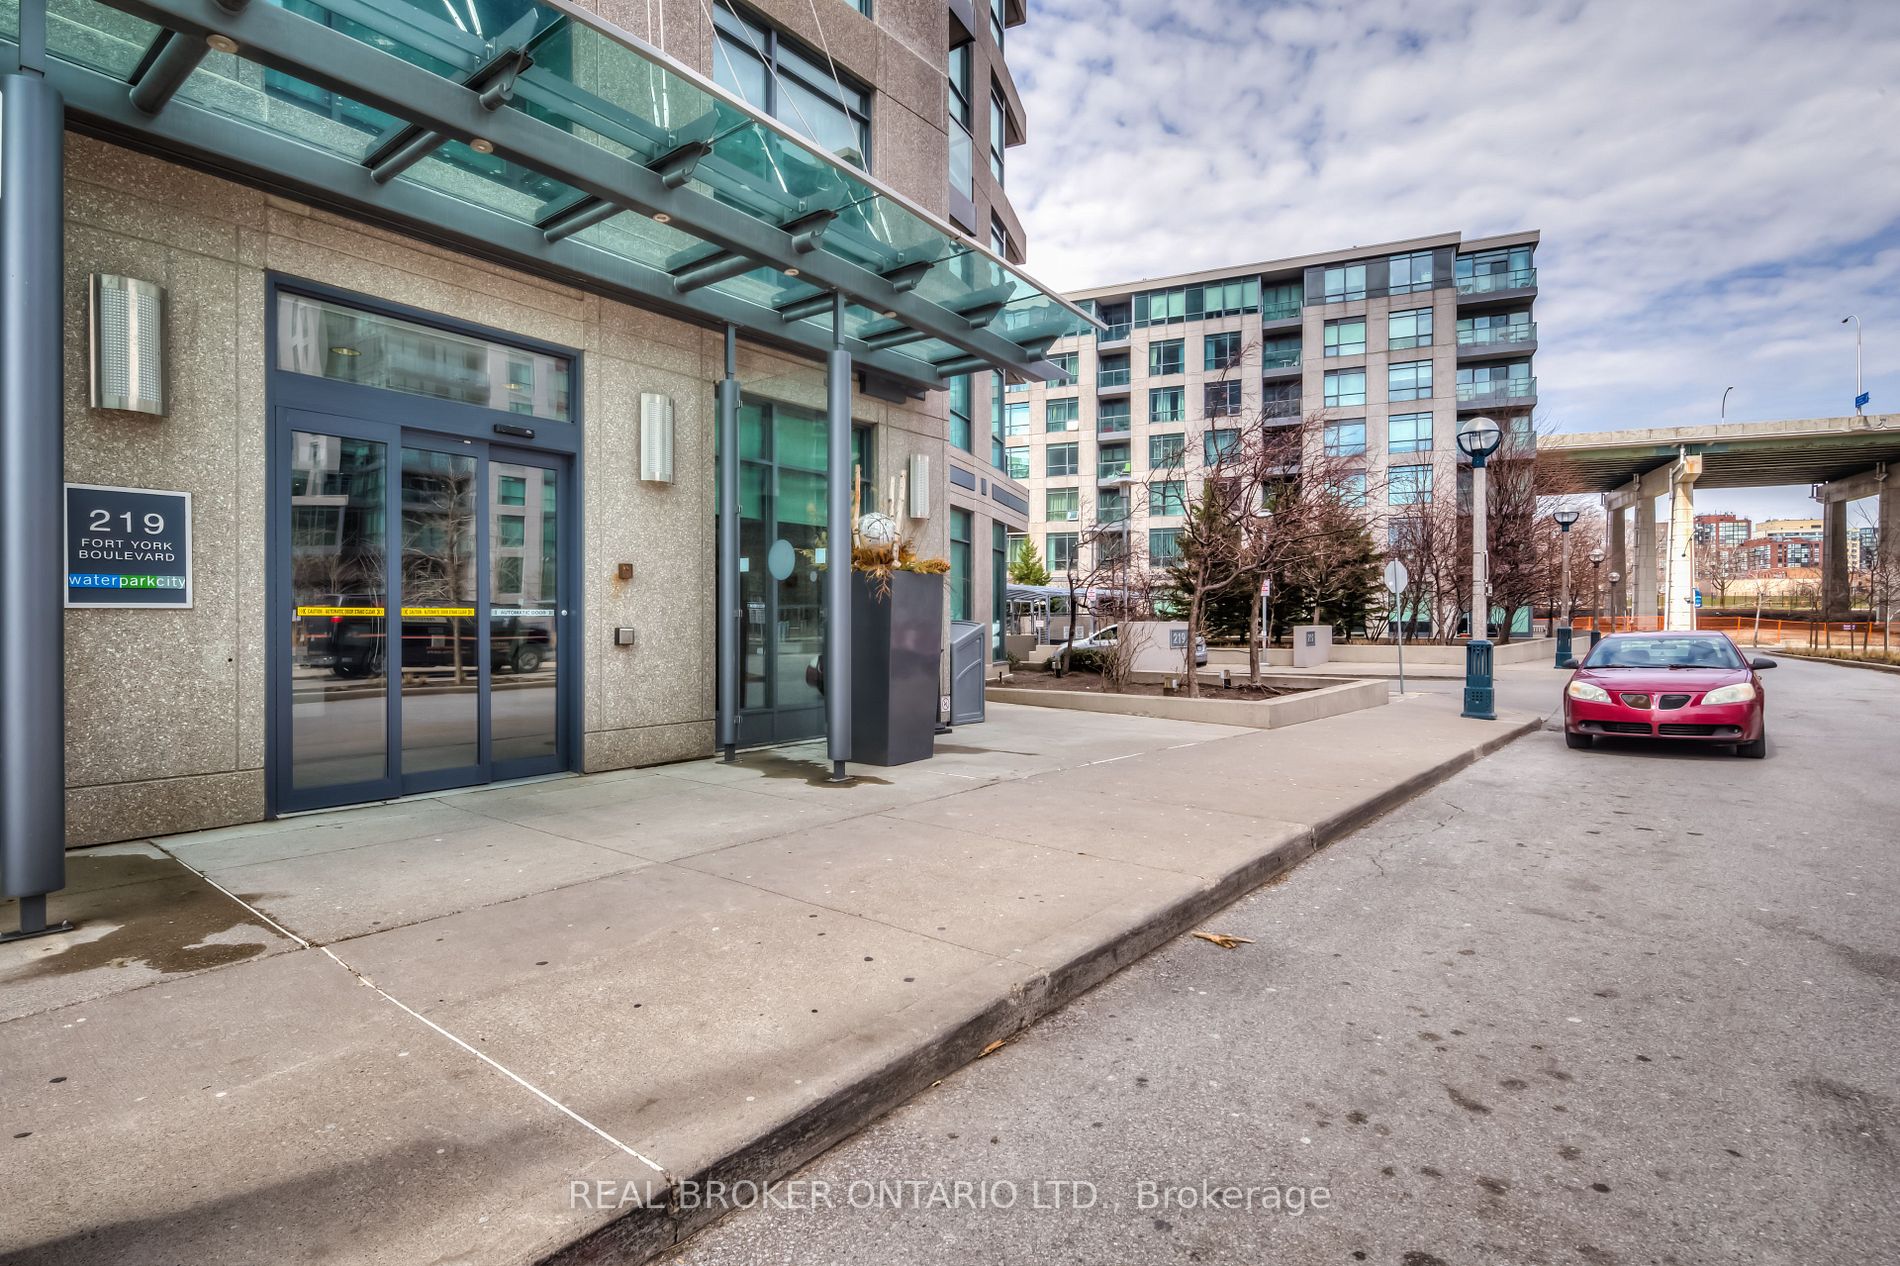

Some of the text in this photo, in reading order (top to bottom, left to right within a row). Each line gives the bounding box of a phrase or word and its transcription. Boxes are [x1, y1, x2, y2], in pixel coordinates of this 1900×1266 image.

[89, 509, 165, 535] 219
[81, 538, 173, 551] FORT YORK
[79, 550, 175, 562] BOULEVARD
[69, 574, 186, 590] waterparkcity
[1172, 632, 1186, 644] 219
